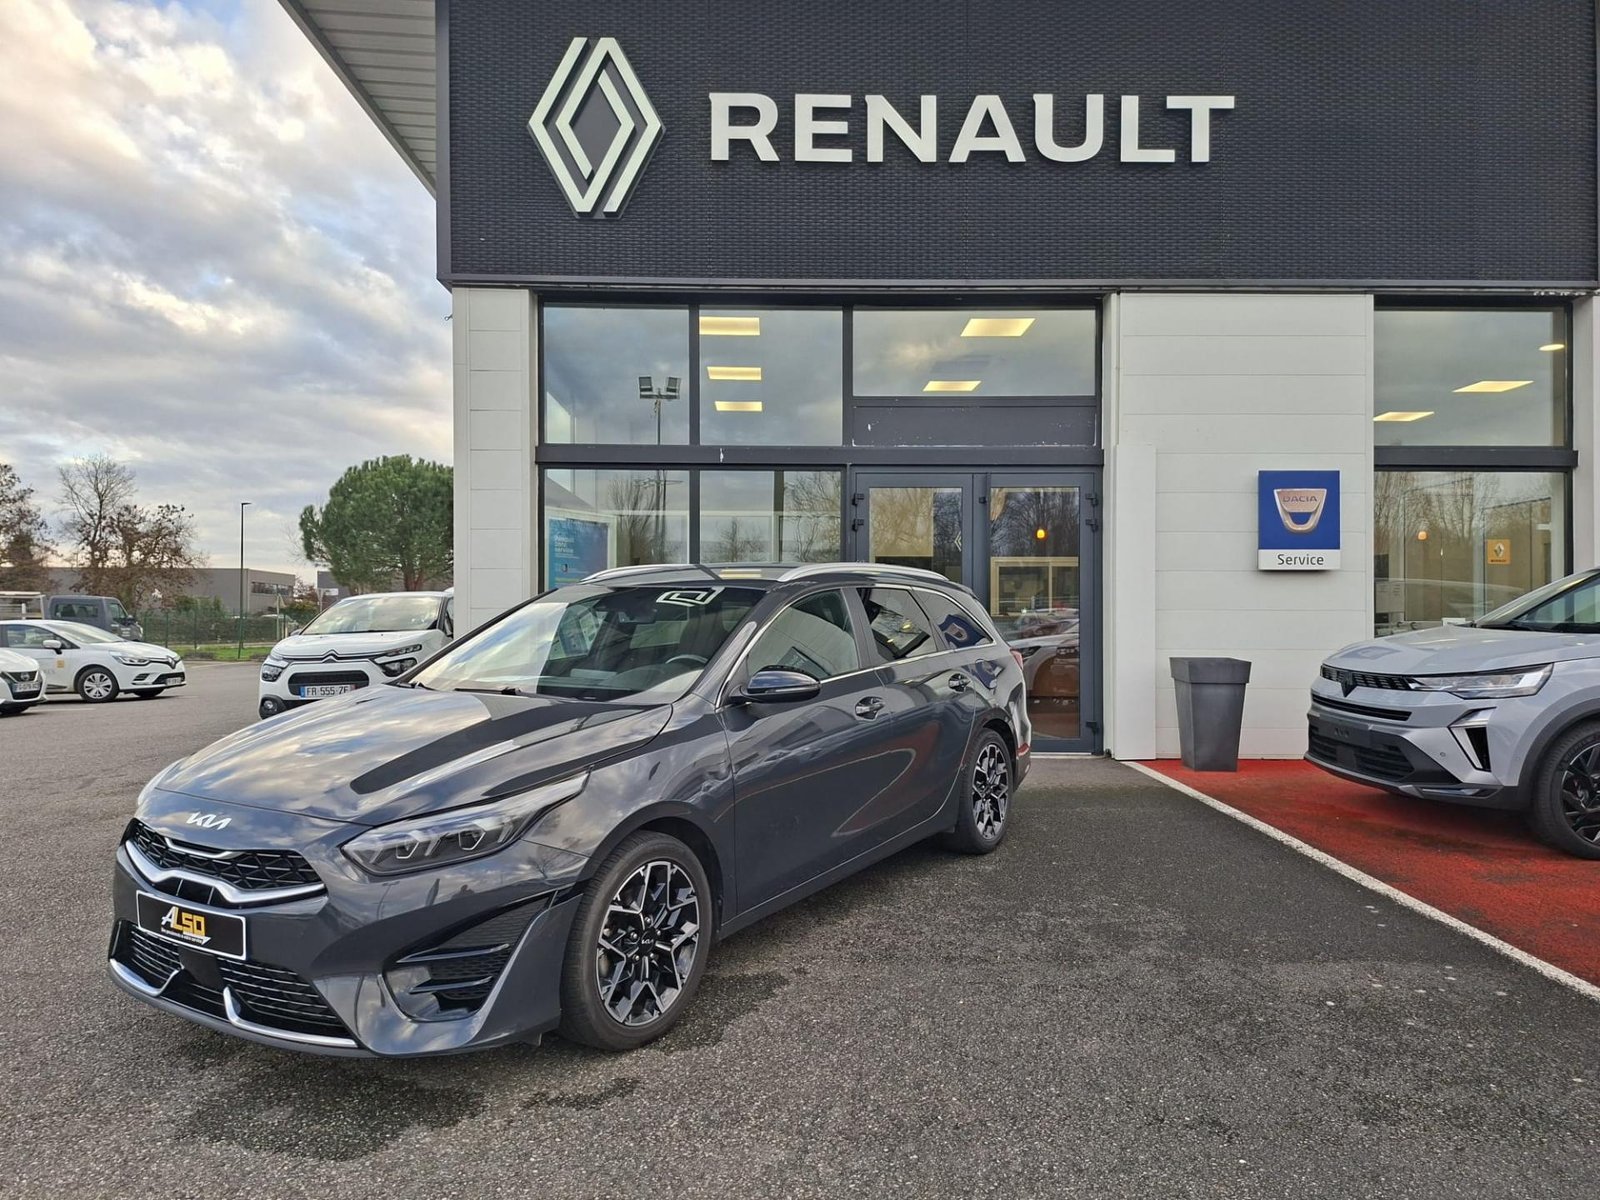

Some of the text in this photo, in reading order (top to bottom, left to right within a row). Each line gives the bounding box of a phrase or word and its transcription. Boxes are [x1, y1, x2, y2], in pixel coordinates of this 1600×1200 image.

[709, 93, 1235, 163] RENAULT
[1282, 495, 1318, 503] DACIA
[1277, 553, 1324, 566] Service
[186, 811, 232, 831] KIA
